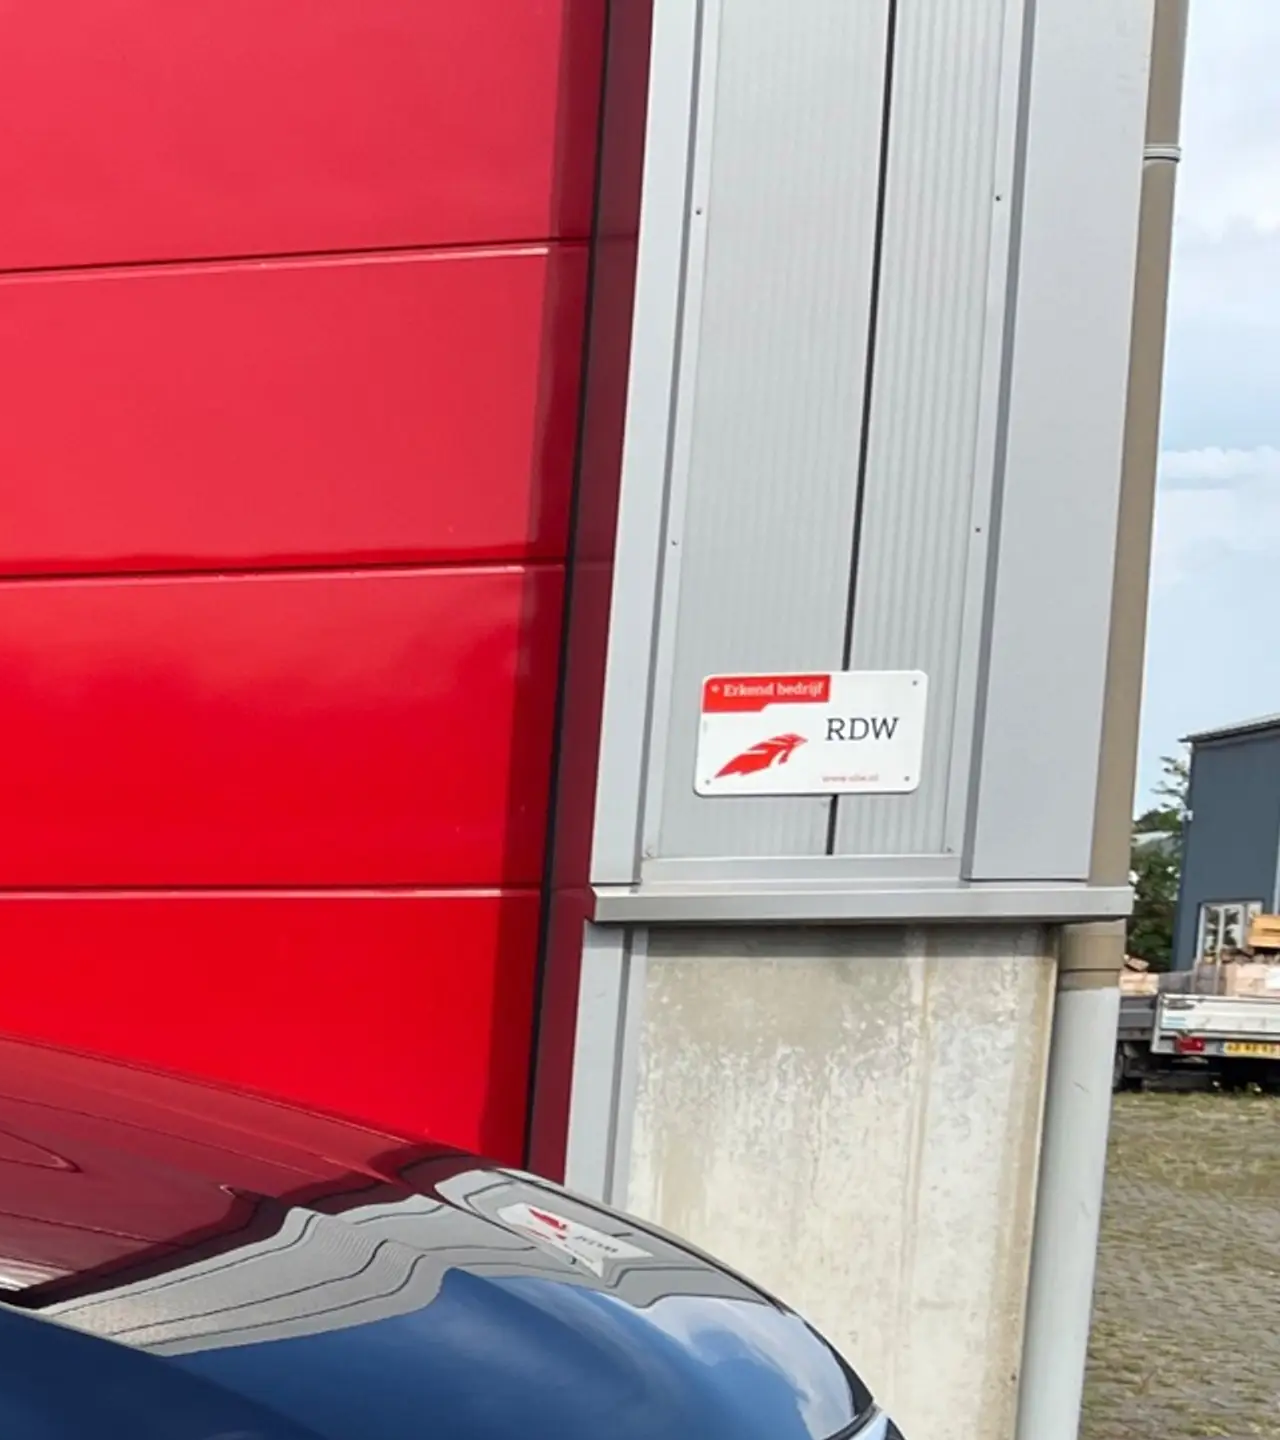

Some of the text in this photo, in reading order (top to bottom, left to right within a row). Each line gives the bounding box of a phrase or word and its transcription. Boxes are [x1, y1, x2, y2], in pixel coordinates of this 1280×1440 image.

[723, 680, 825, 698] Erkend bedrijf
[825, 716, 900, 742] RDW
